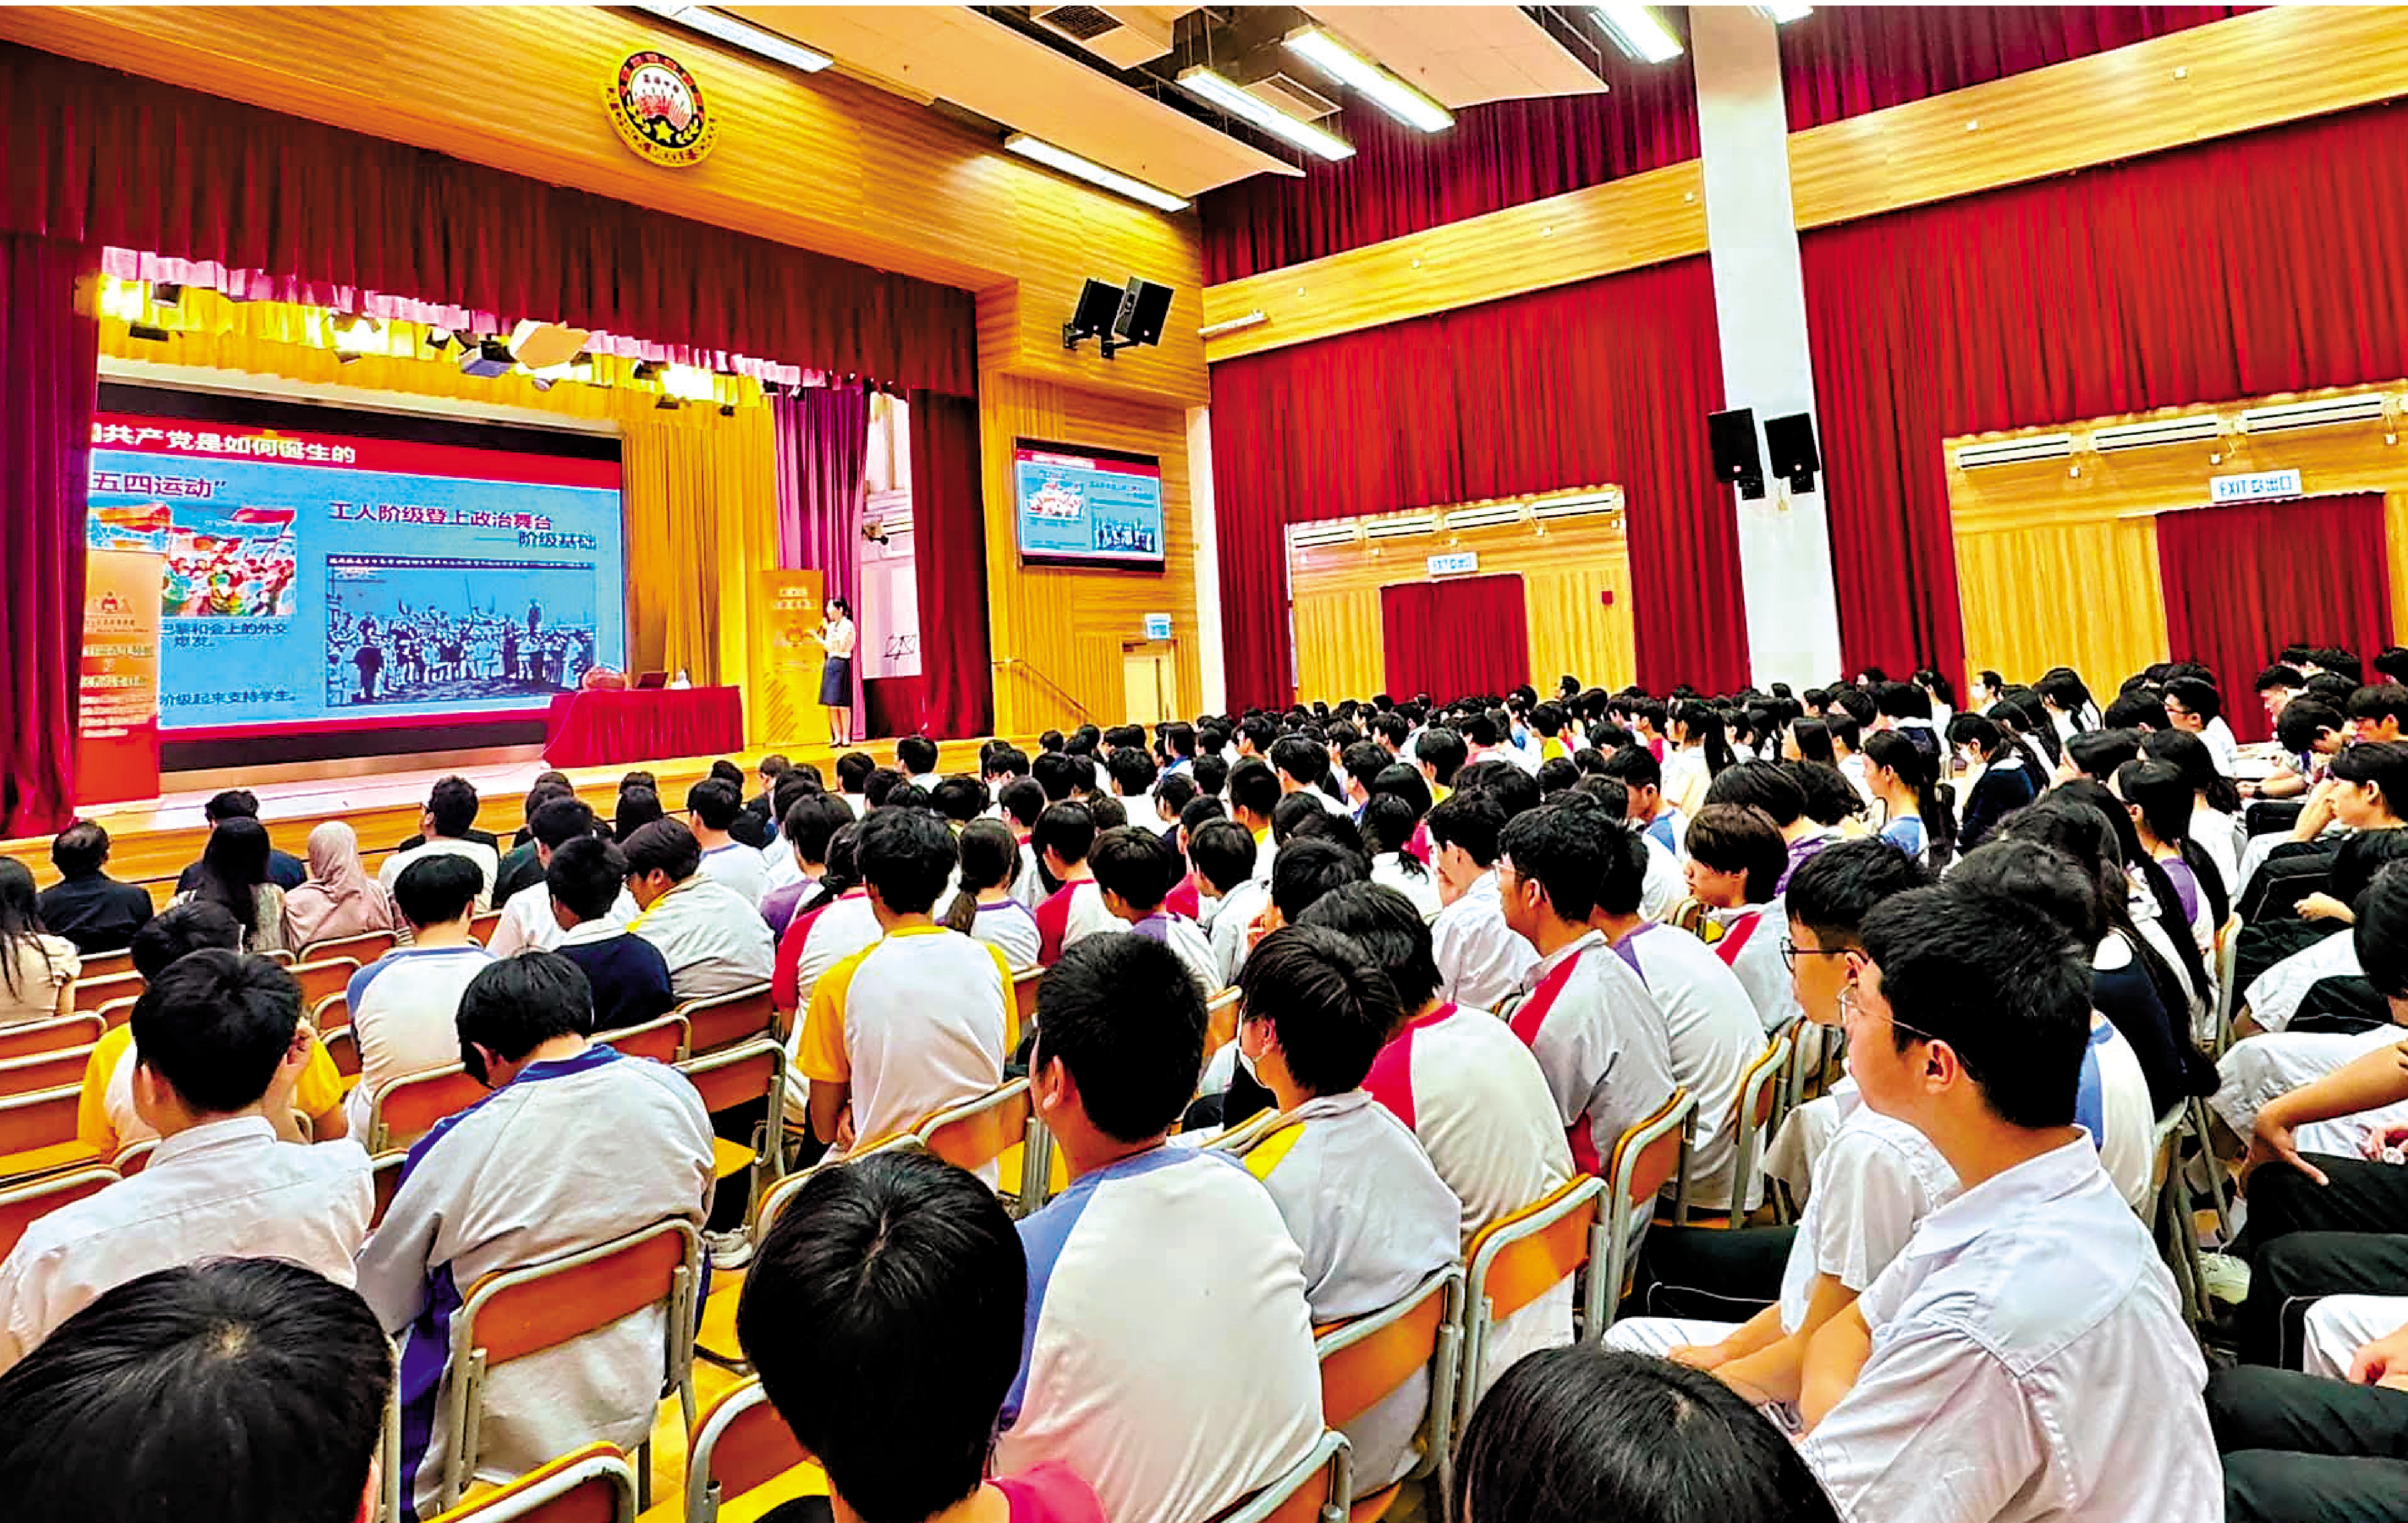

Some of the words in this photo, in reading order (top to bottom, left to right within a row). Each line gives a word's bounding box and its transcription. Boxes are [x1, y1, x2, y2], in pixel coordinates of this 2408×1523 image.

[2219, 480, 2247, 497] EXIT
[330, 502, 552, 530] 工人阶级登上政治舞台
